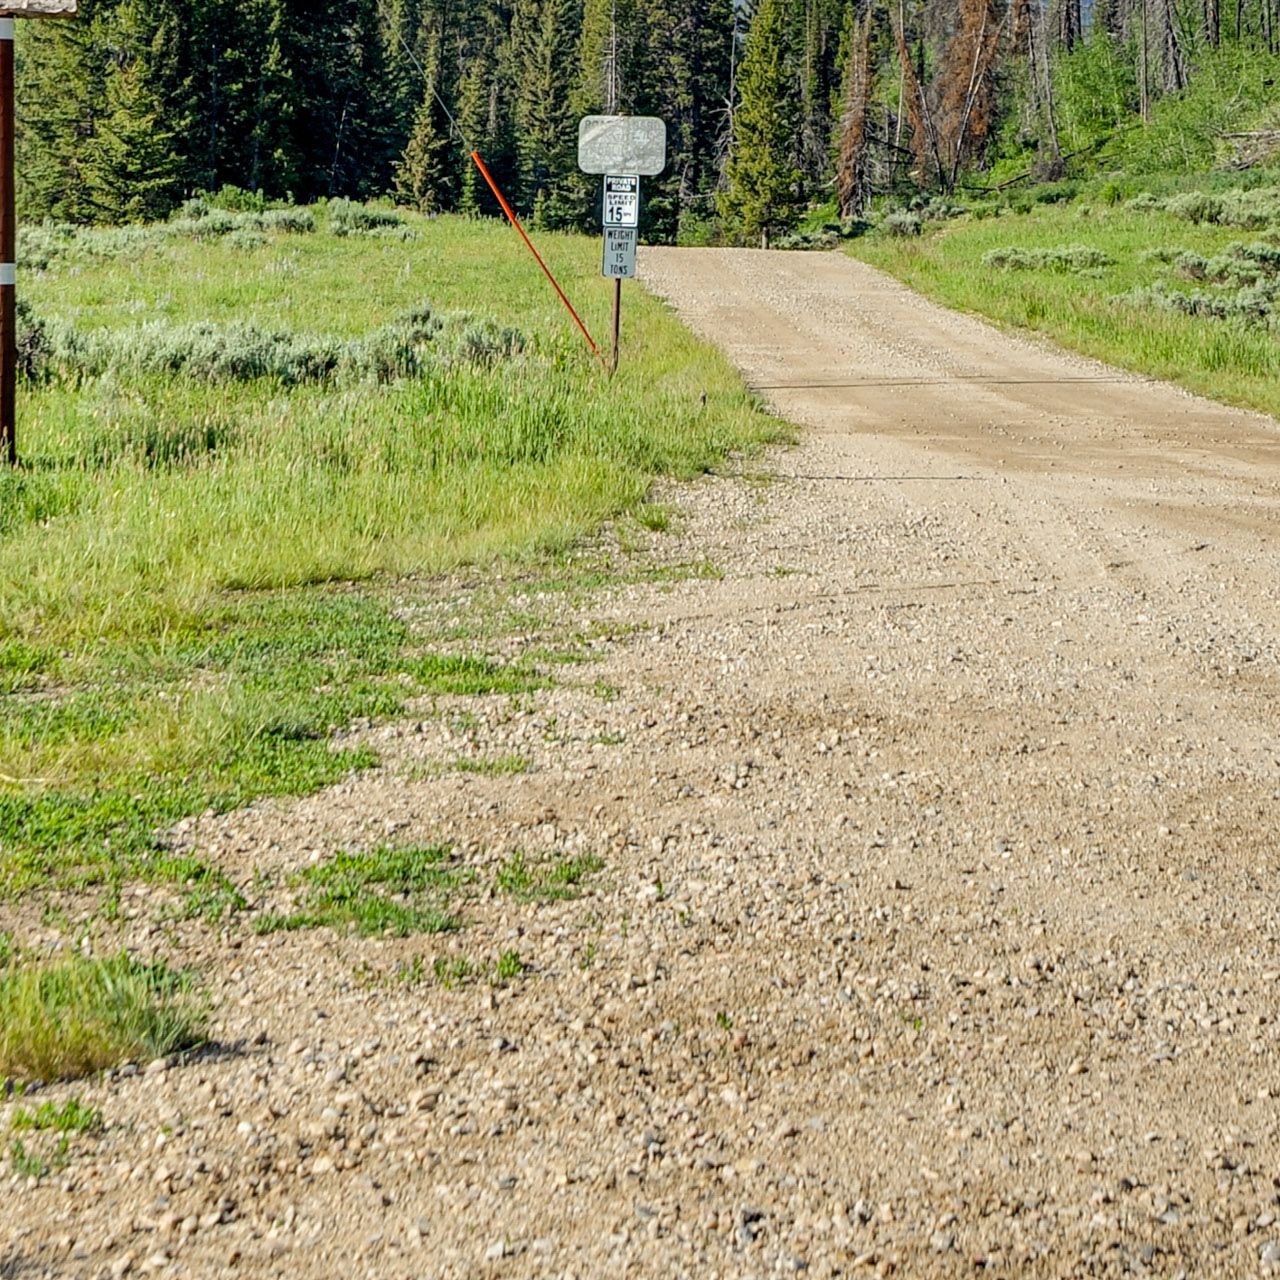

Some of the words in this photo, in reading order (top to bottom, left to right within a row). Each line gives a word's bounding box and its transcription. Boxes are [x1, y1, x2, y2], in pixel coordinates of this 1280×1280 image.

[611, 184, 632, 192] ROAD
[608, 206, 623, 222] 15
[607, 230, 634, 240] WEIGHT
[611, 241, 629, 251] LIMIT
[615, 252, 624, 262] 15
[611, 264, 628, 275] TONS
